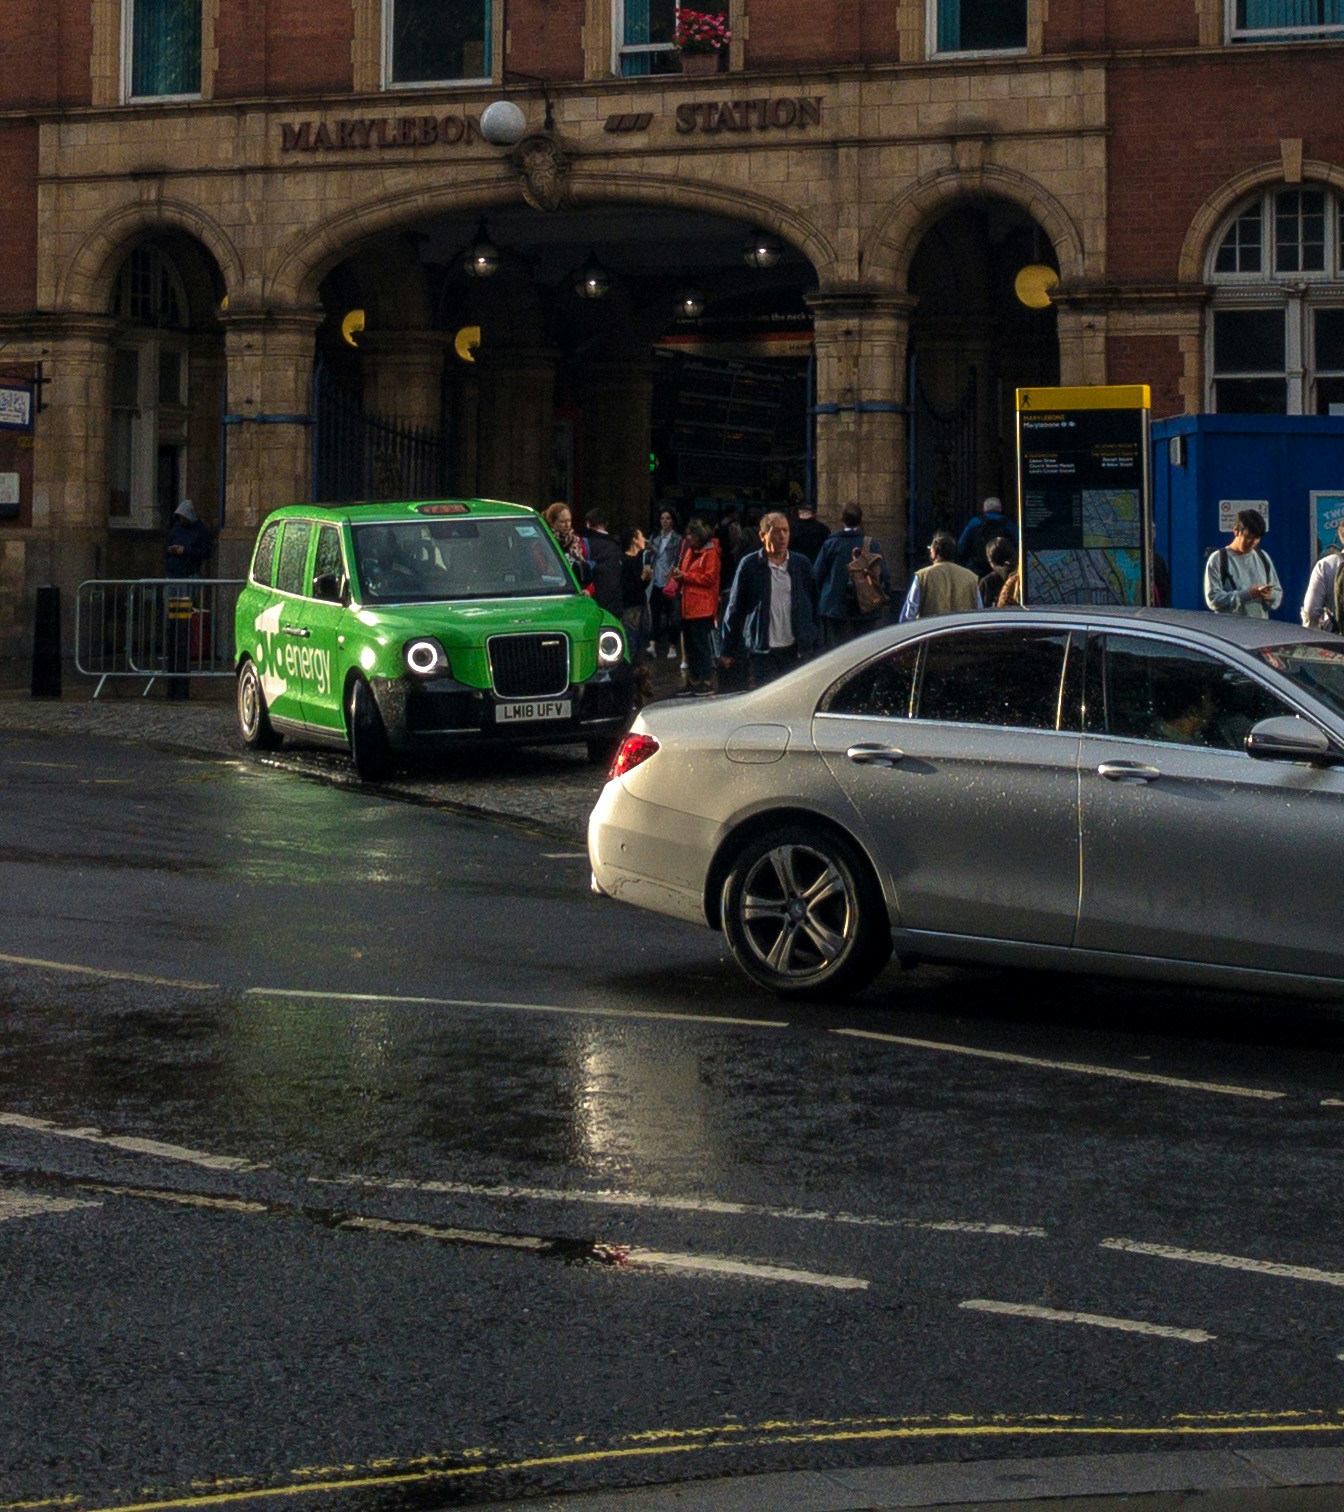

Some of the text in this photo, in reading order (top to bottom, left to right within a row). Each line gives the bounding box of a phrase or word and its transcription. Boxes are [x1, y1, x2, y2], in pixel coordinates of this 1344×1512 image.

[280, 96, 824, 151] MARYLEBON STATION
[285, 643, 331, 694] energy
[504, 703, 534, 720] LM18
